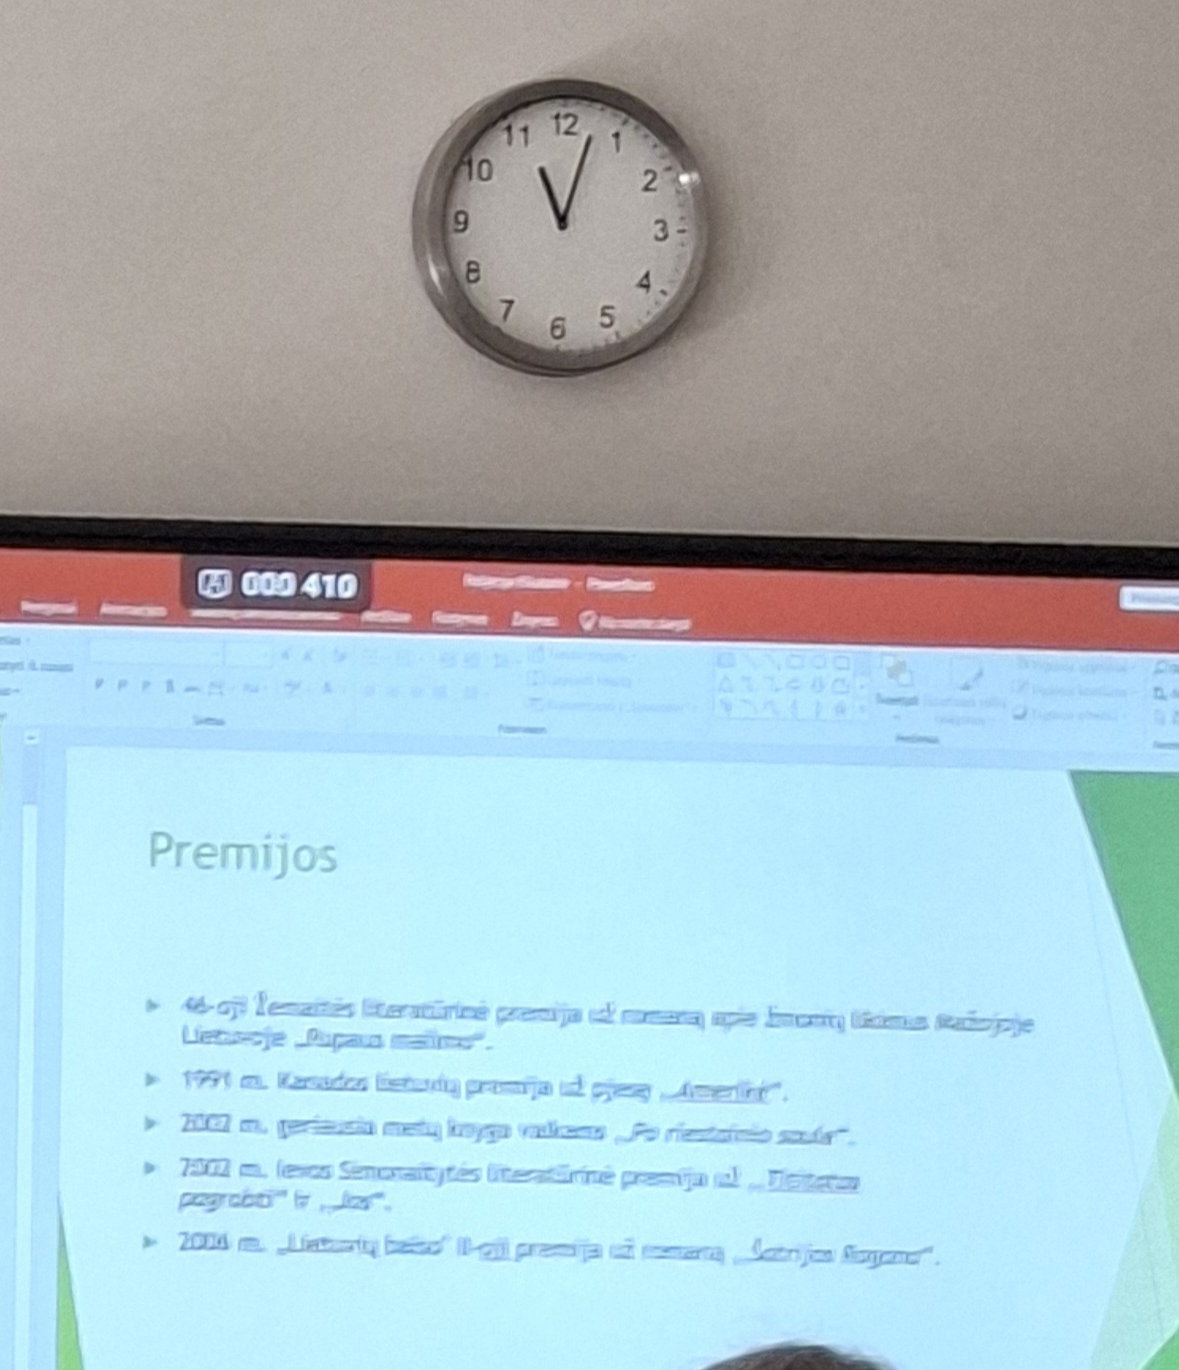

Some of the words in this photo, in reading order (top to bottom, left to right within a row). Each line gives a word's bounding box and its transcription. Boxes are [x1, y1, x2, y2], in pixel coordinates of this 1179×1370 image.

[503, 122, 530, 148] 11
[552, 112, 580, 136] 12
[611, 131, 621, 153] 1
[462, 156, 494, 182] 10
[641, 169, 658, 192] 2
[453, 209, 469, 234] 9
[653, 219, 670, 242] 3
[465, 260, 482, 284] 8
[635, 270, 651, 294] 4
[498, 298, 515, 323] 7
[599, 304, 616, 329] 5
[550, 316, 567, 340] 6
[300, 572, 358, 599] 410
[150, 831, 338, 880] Premijos
